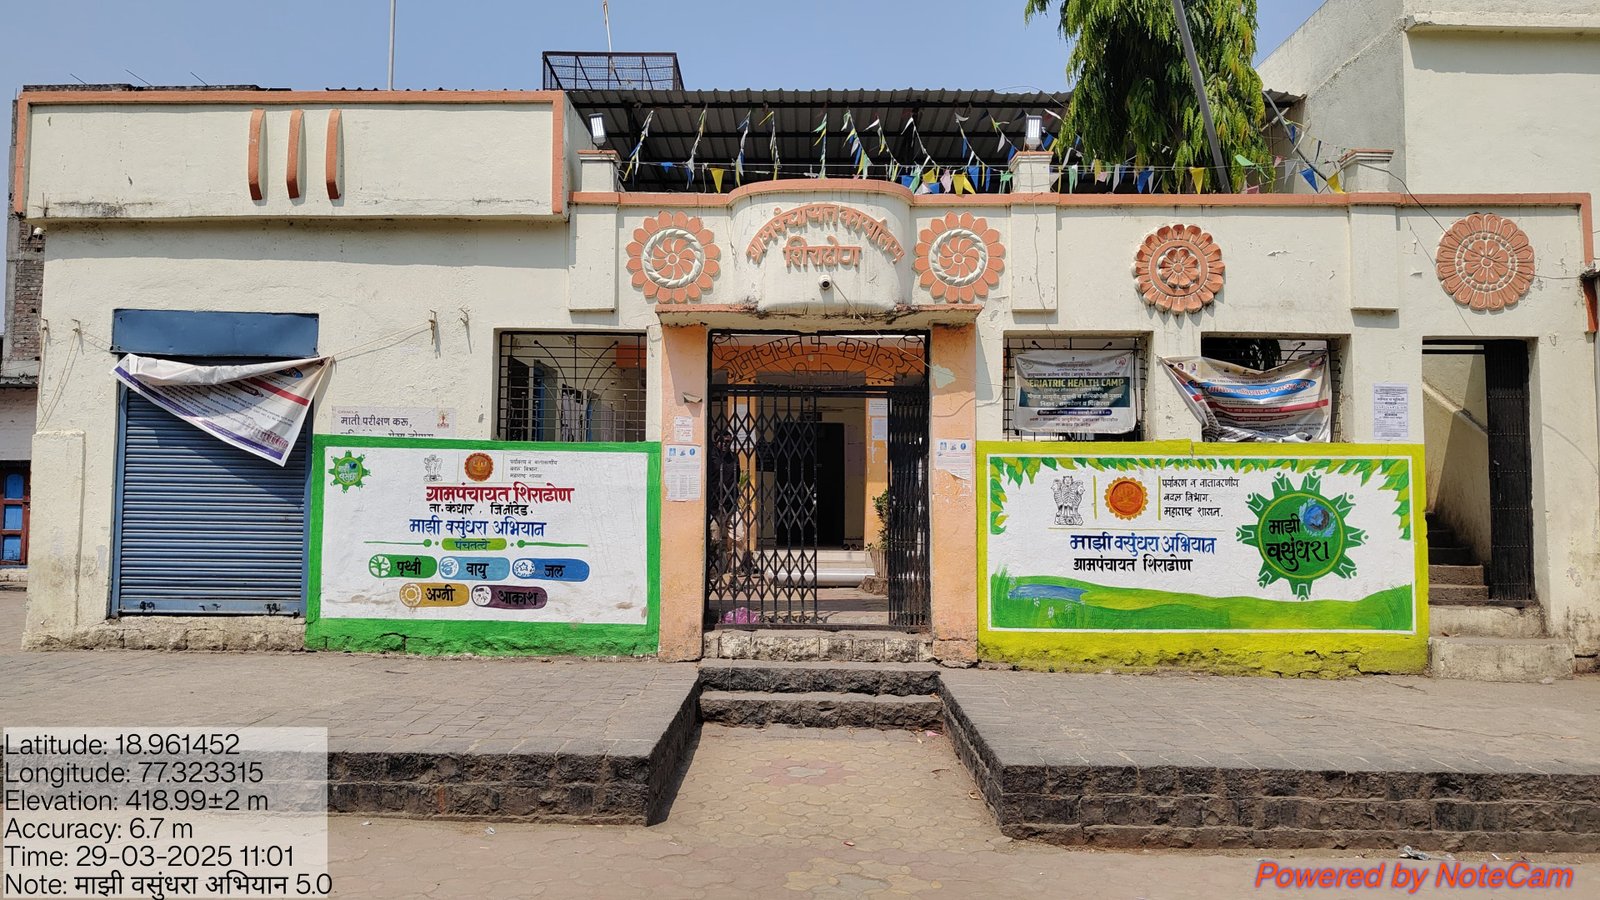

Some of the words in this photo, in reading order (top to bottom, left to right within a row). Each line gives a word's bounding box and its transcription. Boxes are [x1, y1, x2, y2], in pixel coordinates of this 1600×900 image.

[746, 203, 840, 264] ग्रामपंचायत
[839, 205, 905, 264] कार्यालय
[783, 235, 861, 267] शिराढोण
[1068, 379, 1099, 387] HEALTH
[340, 414, 360, 426] माती
[362, 415, 390, 426] परीक्षण
[426, 482, 511, 502] ग्रामपंचायत
[513, 481, 574, 503] शिराढोण
[1164, 507, 1194, 517] महाराष्ट्र
[409, 515, 443, 536] माझी
[446, 517, 489, 539] वसुंधरा
[493, 516, 546, 537] अभियान
[1268, 513, 1300, 538] माझी
[1070, 532, 1113, 552] माझी
[1115, 533, 1160, 557] वसुंधरा
[1162, 533, 1217, 554] अभियान
[1266, 537, 1330, 572] वसुंधरा
[397, 558, 422, 577] पृथ्वी
[467, 562, 489, 578] वायु
[545, 564, 566, 578] जल
[1073, 555, 1137, 571] ग्रामपंचायत
[1143, 554, 1193, 573] शिराढोण
[425, 584, 456, 602] अग्नी
[498, 591, 538, 605] आकाश
